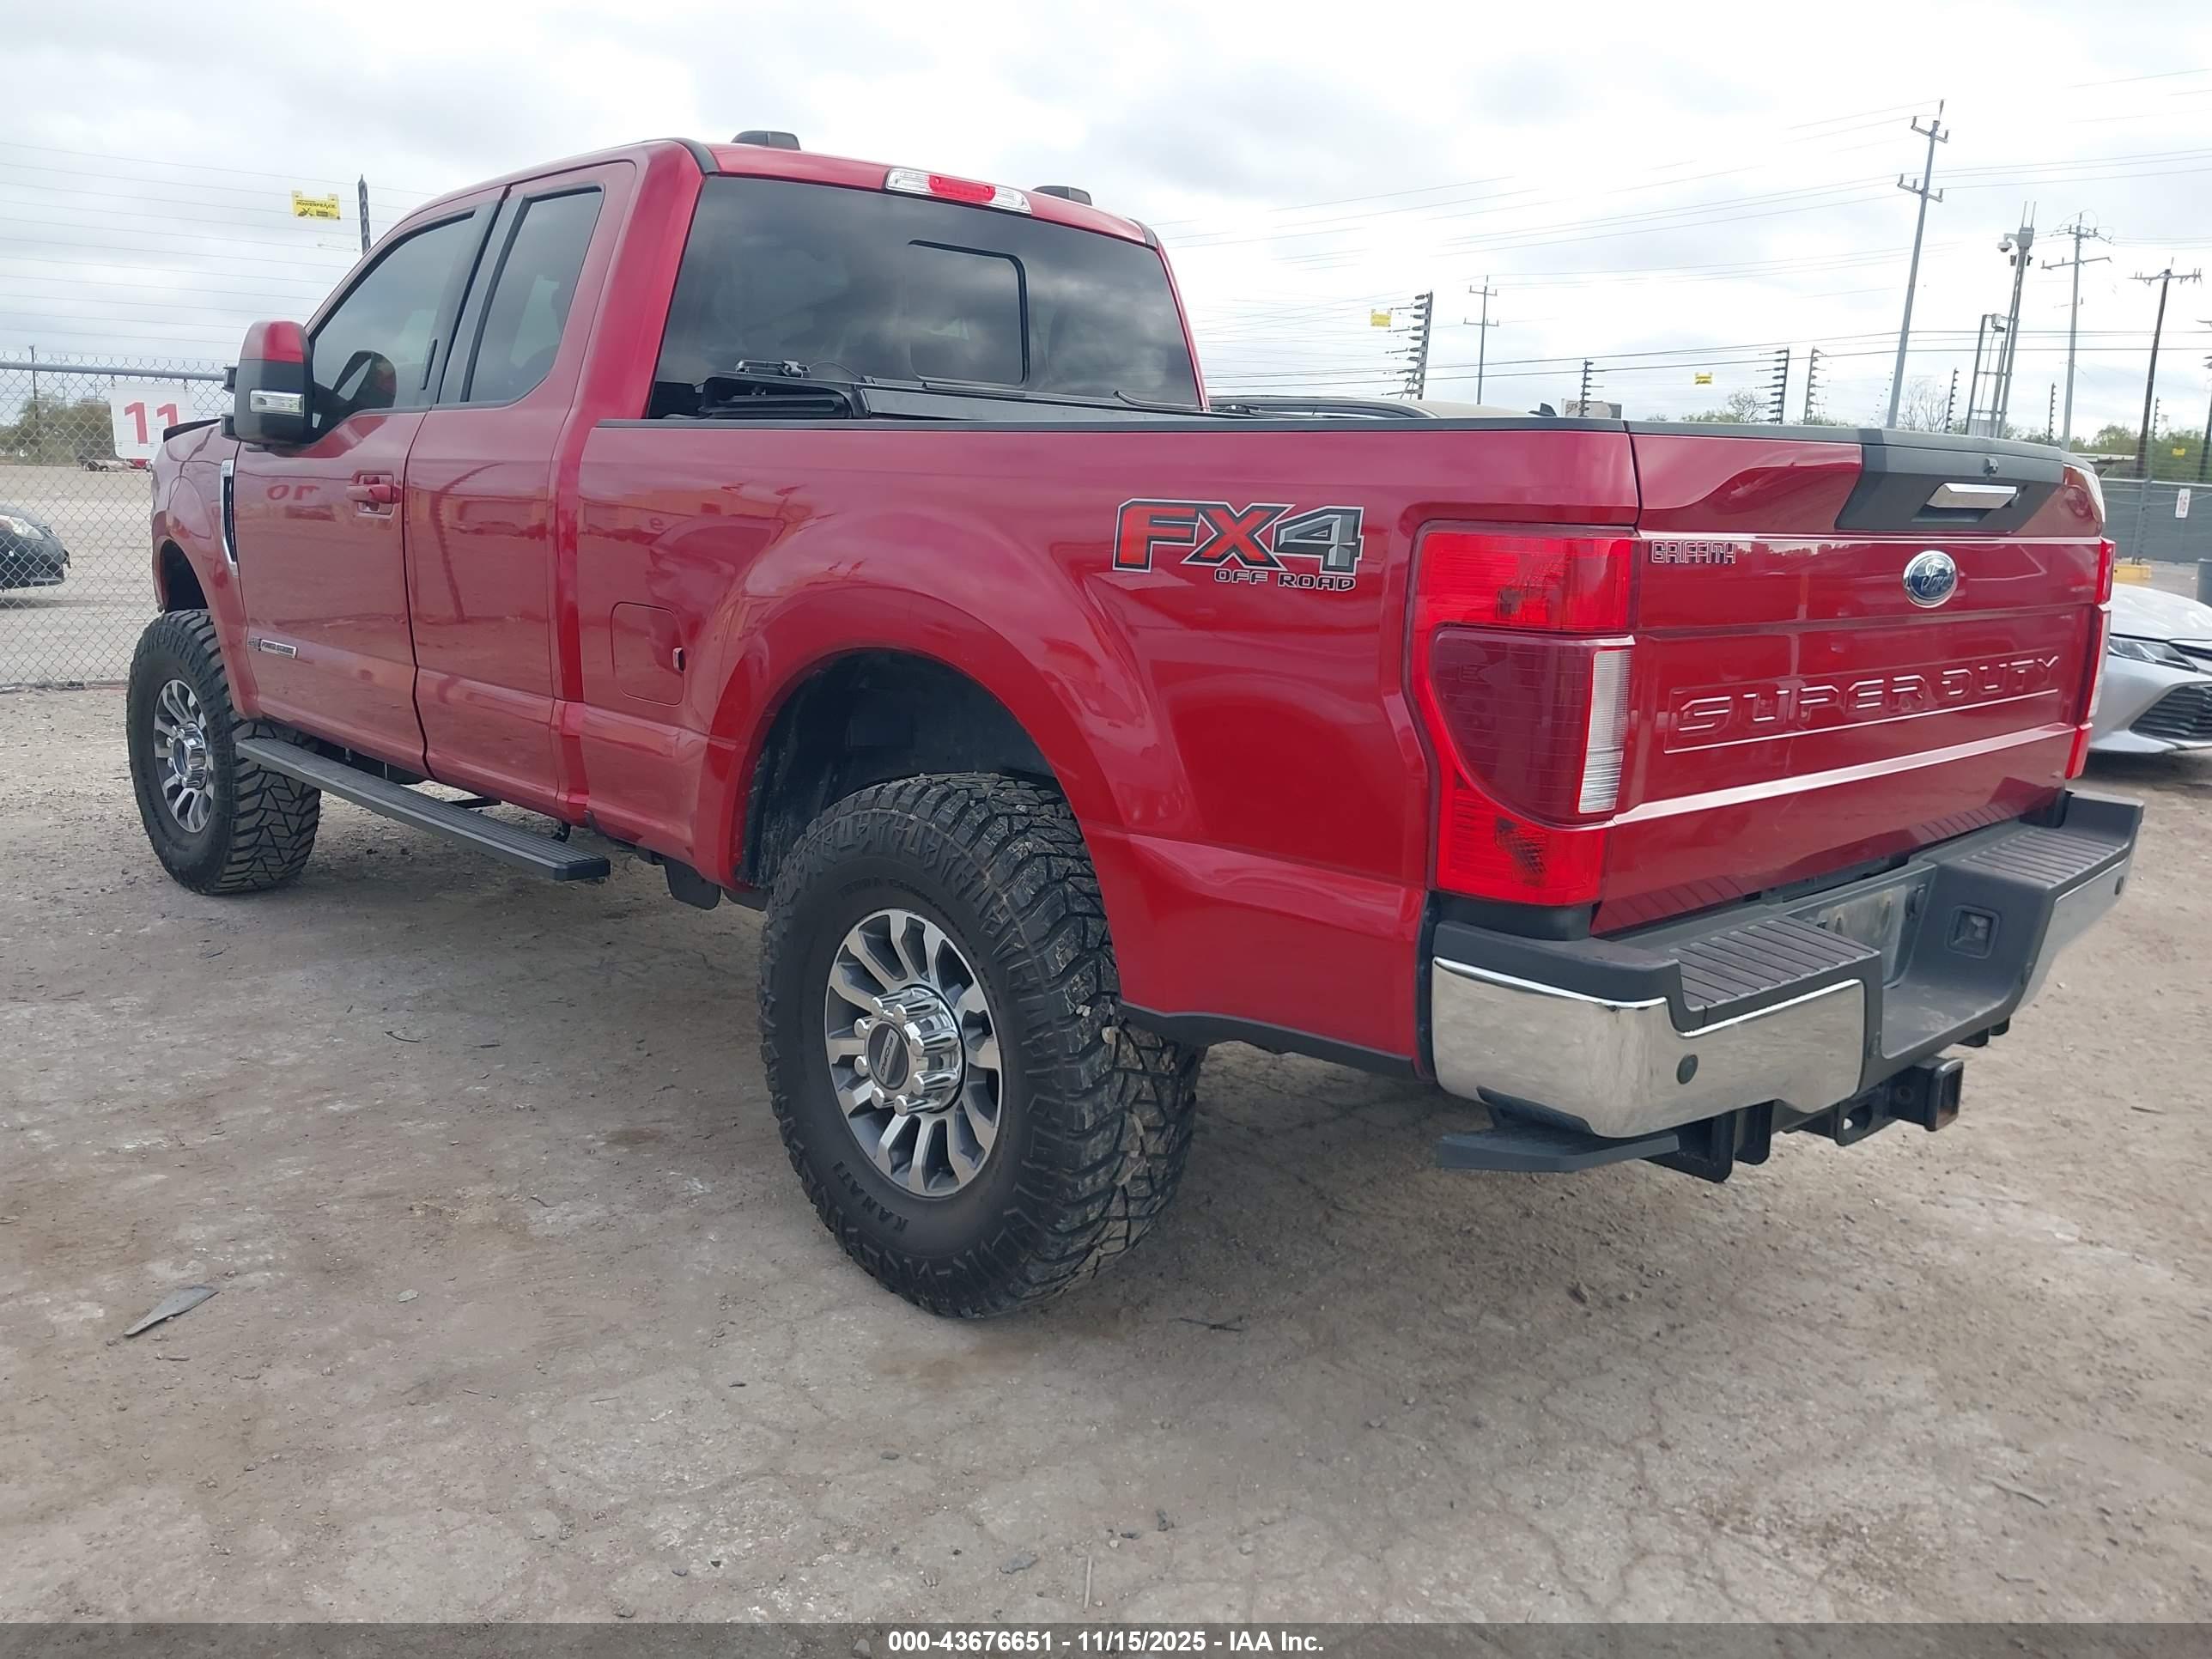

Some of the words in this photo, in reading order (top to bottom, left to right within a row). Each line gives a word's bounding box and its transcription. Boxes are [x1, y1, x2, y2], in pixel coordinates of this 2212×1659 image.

[1112, 498, 1364, 576] FX4
[1651, 540, 1736, 564] GRIFFITH
[1213, 568, 1268, 585] OFF
[1278, 571, 1357, 592] ROAD
[1676, 674, 1936, 734] SUPER
[1941, 655, 2060, 700] DUTY
[880, 1036, 894, 1077] FORD
[832, 1160, 910, 1232] KANATI
